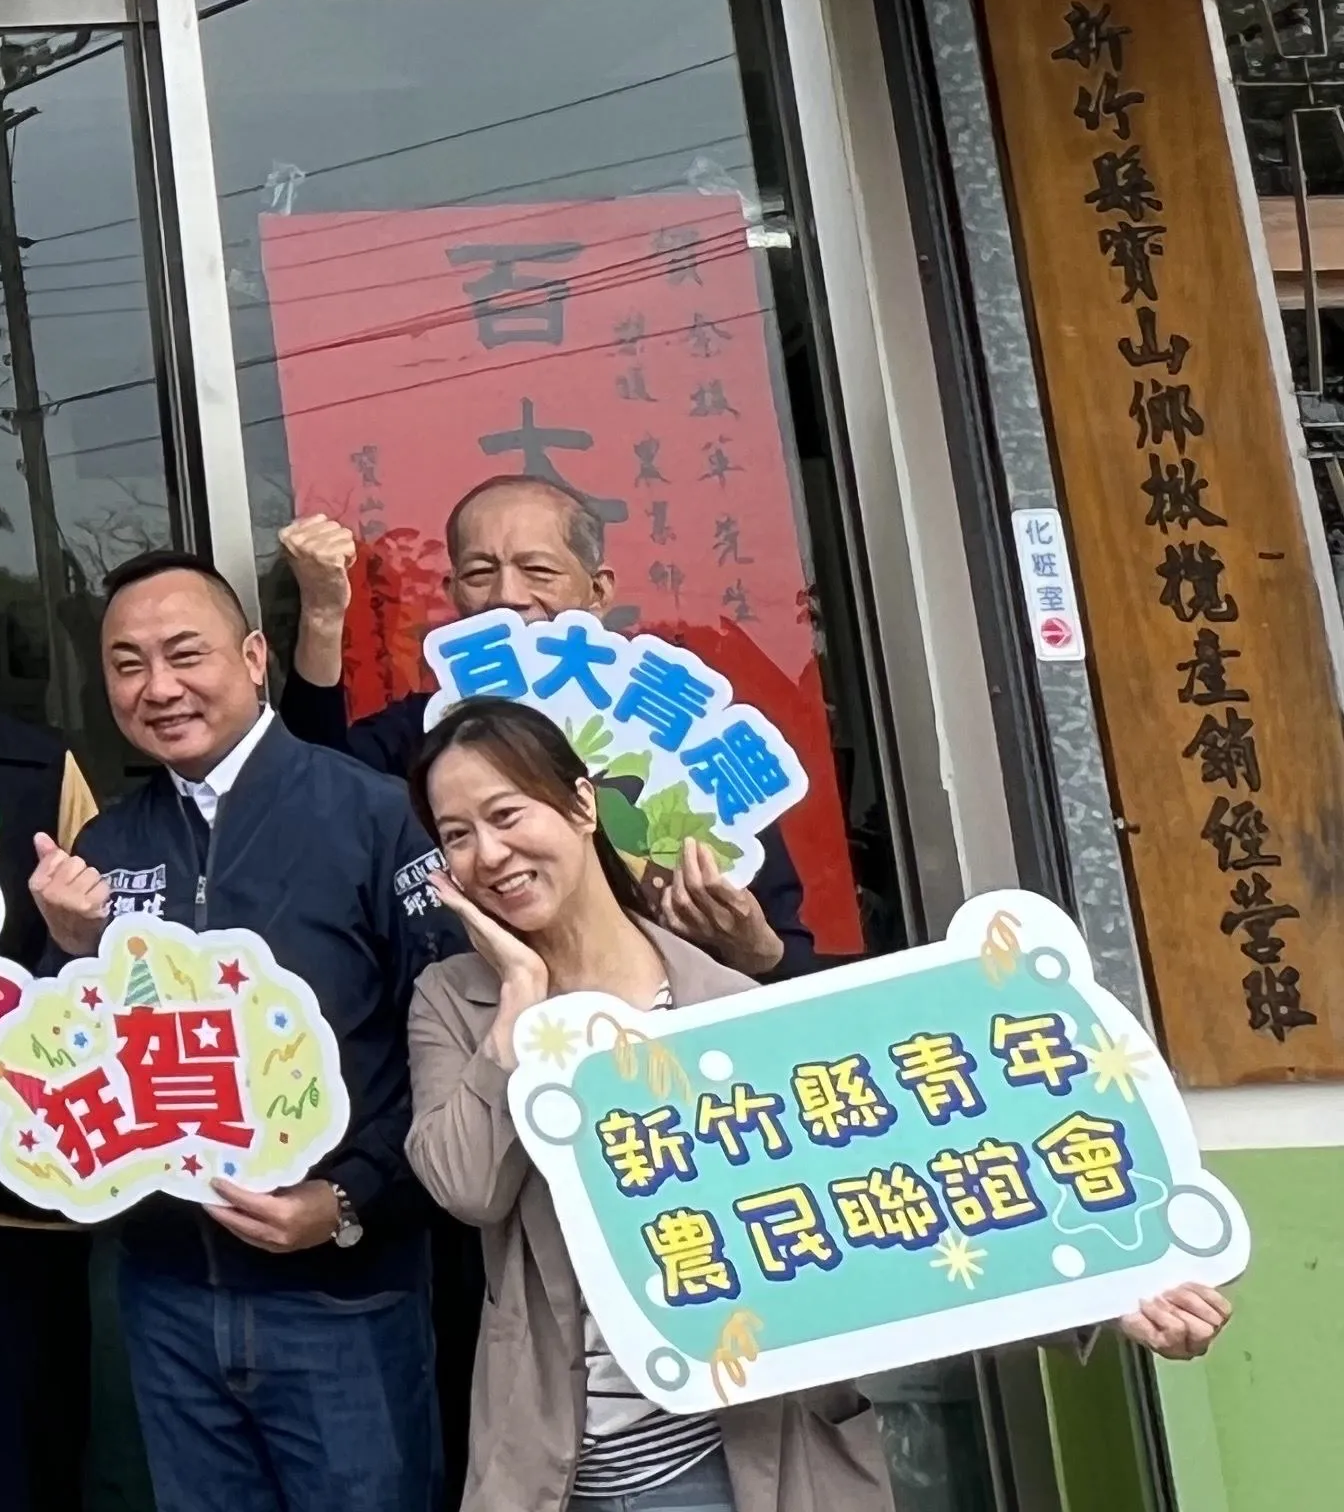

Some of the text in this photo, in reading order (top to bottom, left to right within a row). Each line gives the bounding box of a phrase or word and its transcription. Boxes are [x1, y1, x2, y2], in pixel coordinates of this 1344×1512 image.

[439, 623, 791, 826] 百大青農
[40, 1005, 257, 1182] 狂賀
[595, 1012, 1090, 1200] 新竹縣青年
[640, 1110, 1138, 1308] 農民聯誼會
